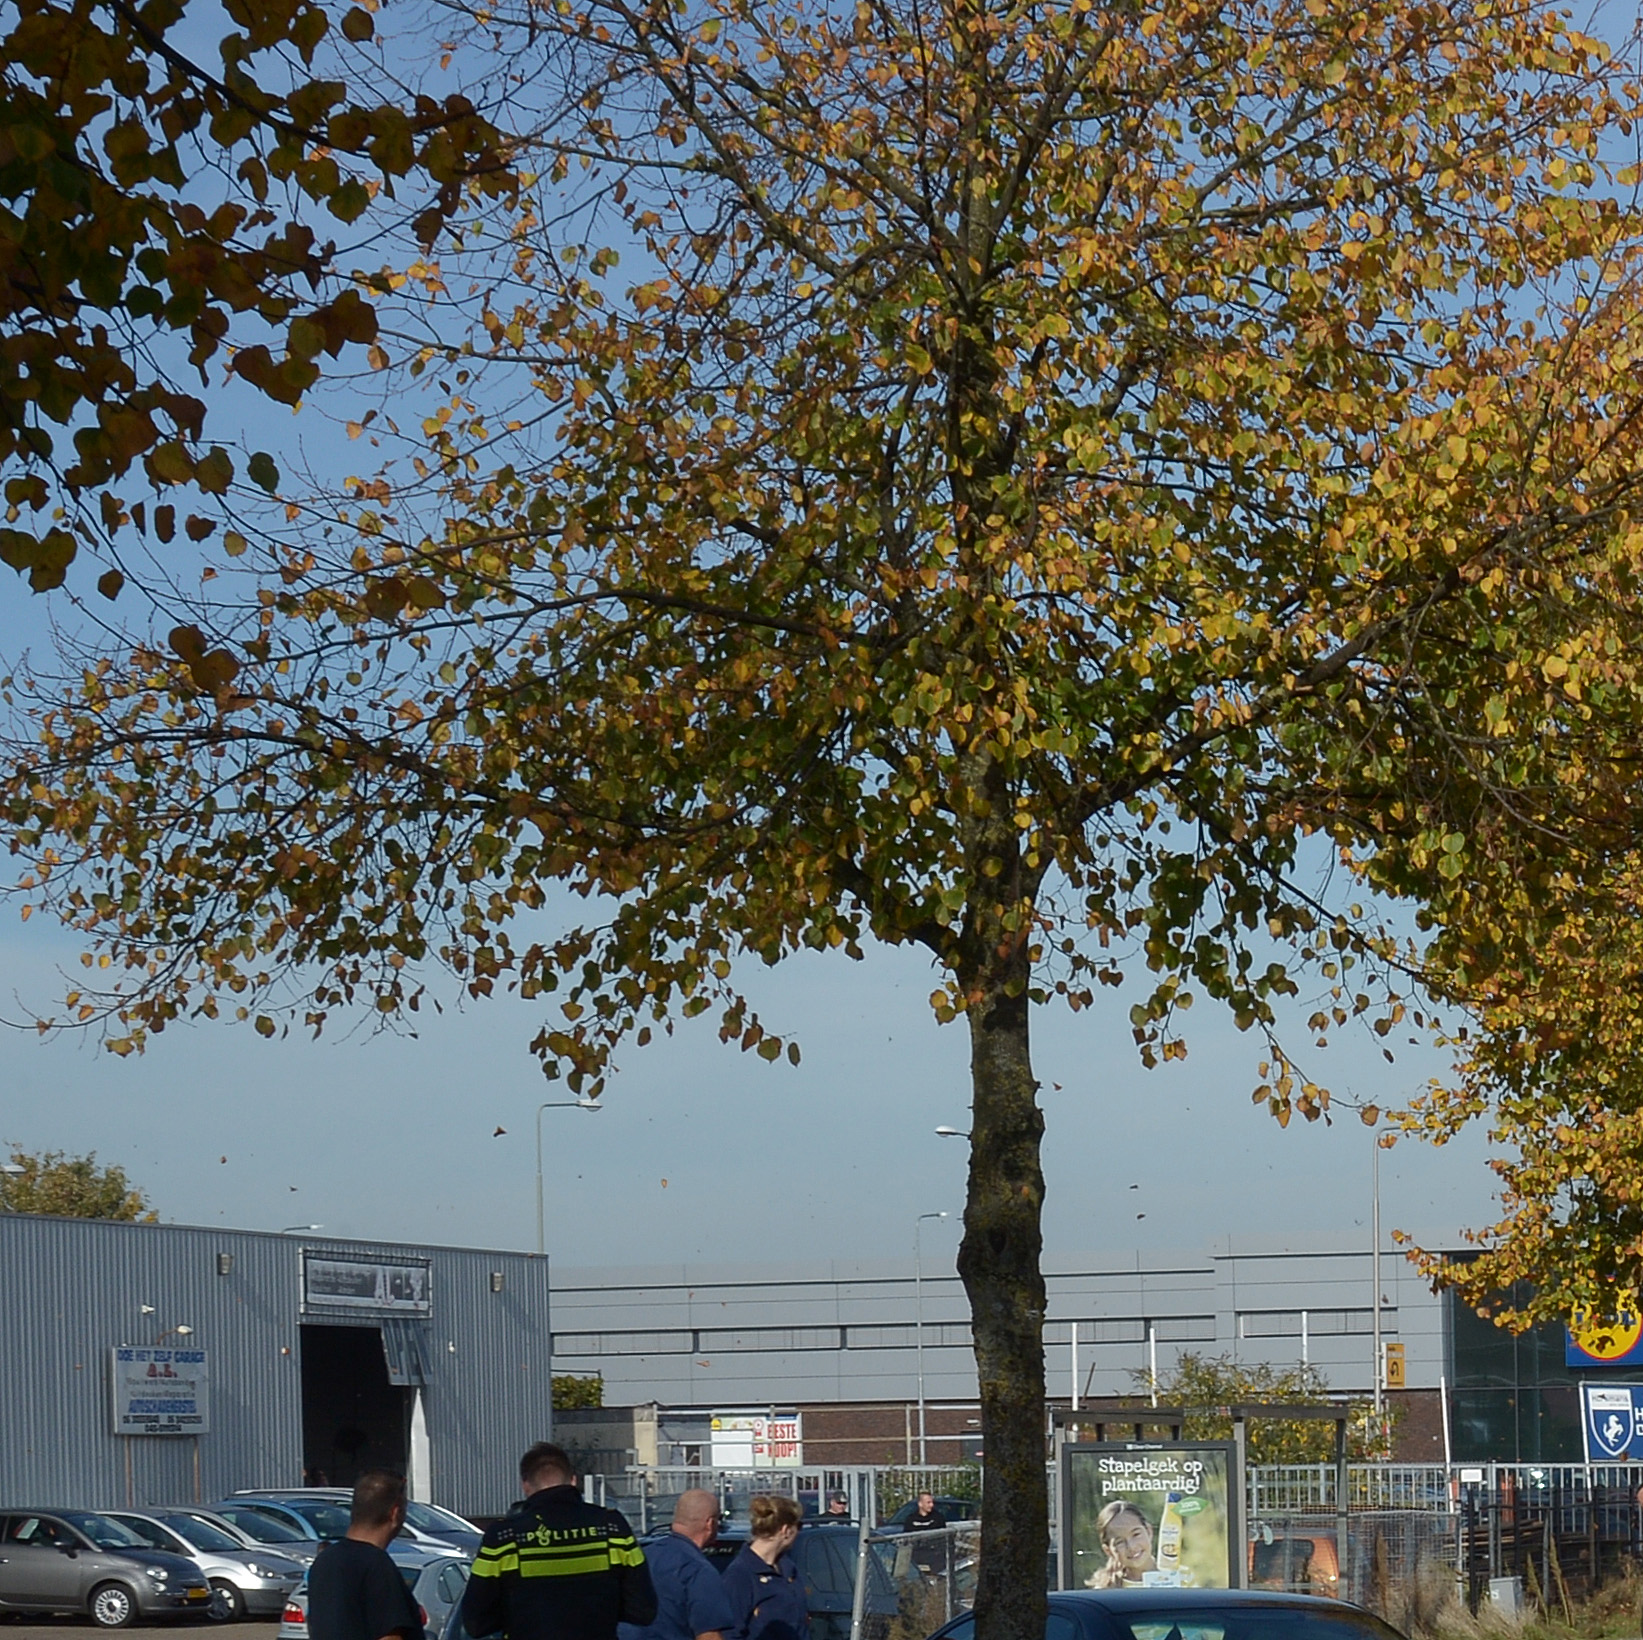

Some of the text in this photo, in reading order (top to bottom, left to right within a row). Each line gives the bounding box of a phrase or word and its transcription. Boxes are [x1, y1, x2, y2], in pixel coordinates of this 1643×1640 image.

[1098, 1456, 1203, 1477] Stapelgek op
[1102, 1475, 1200, 1496] plantaardig!
